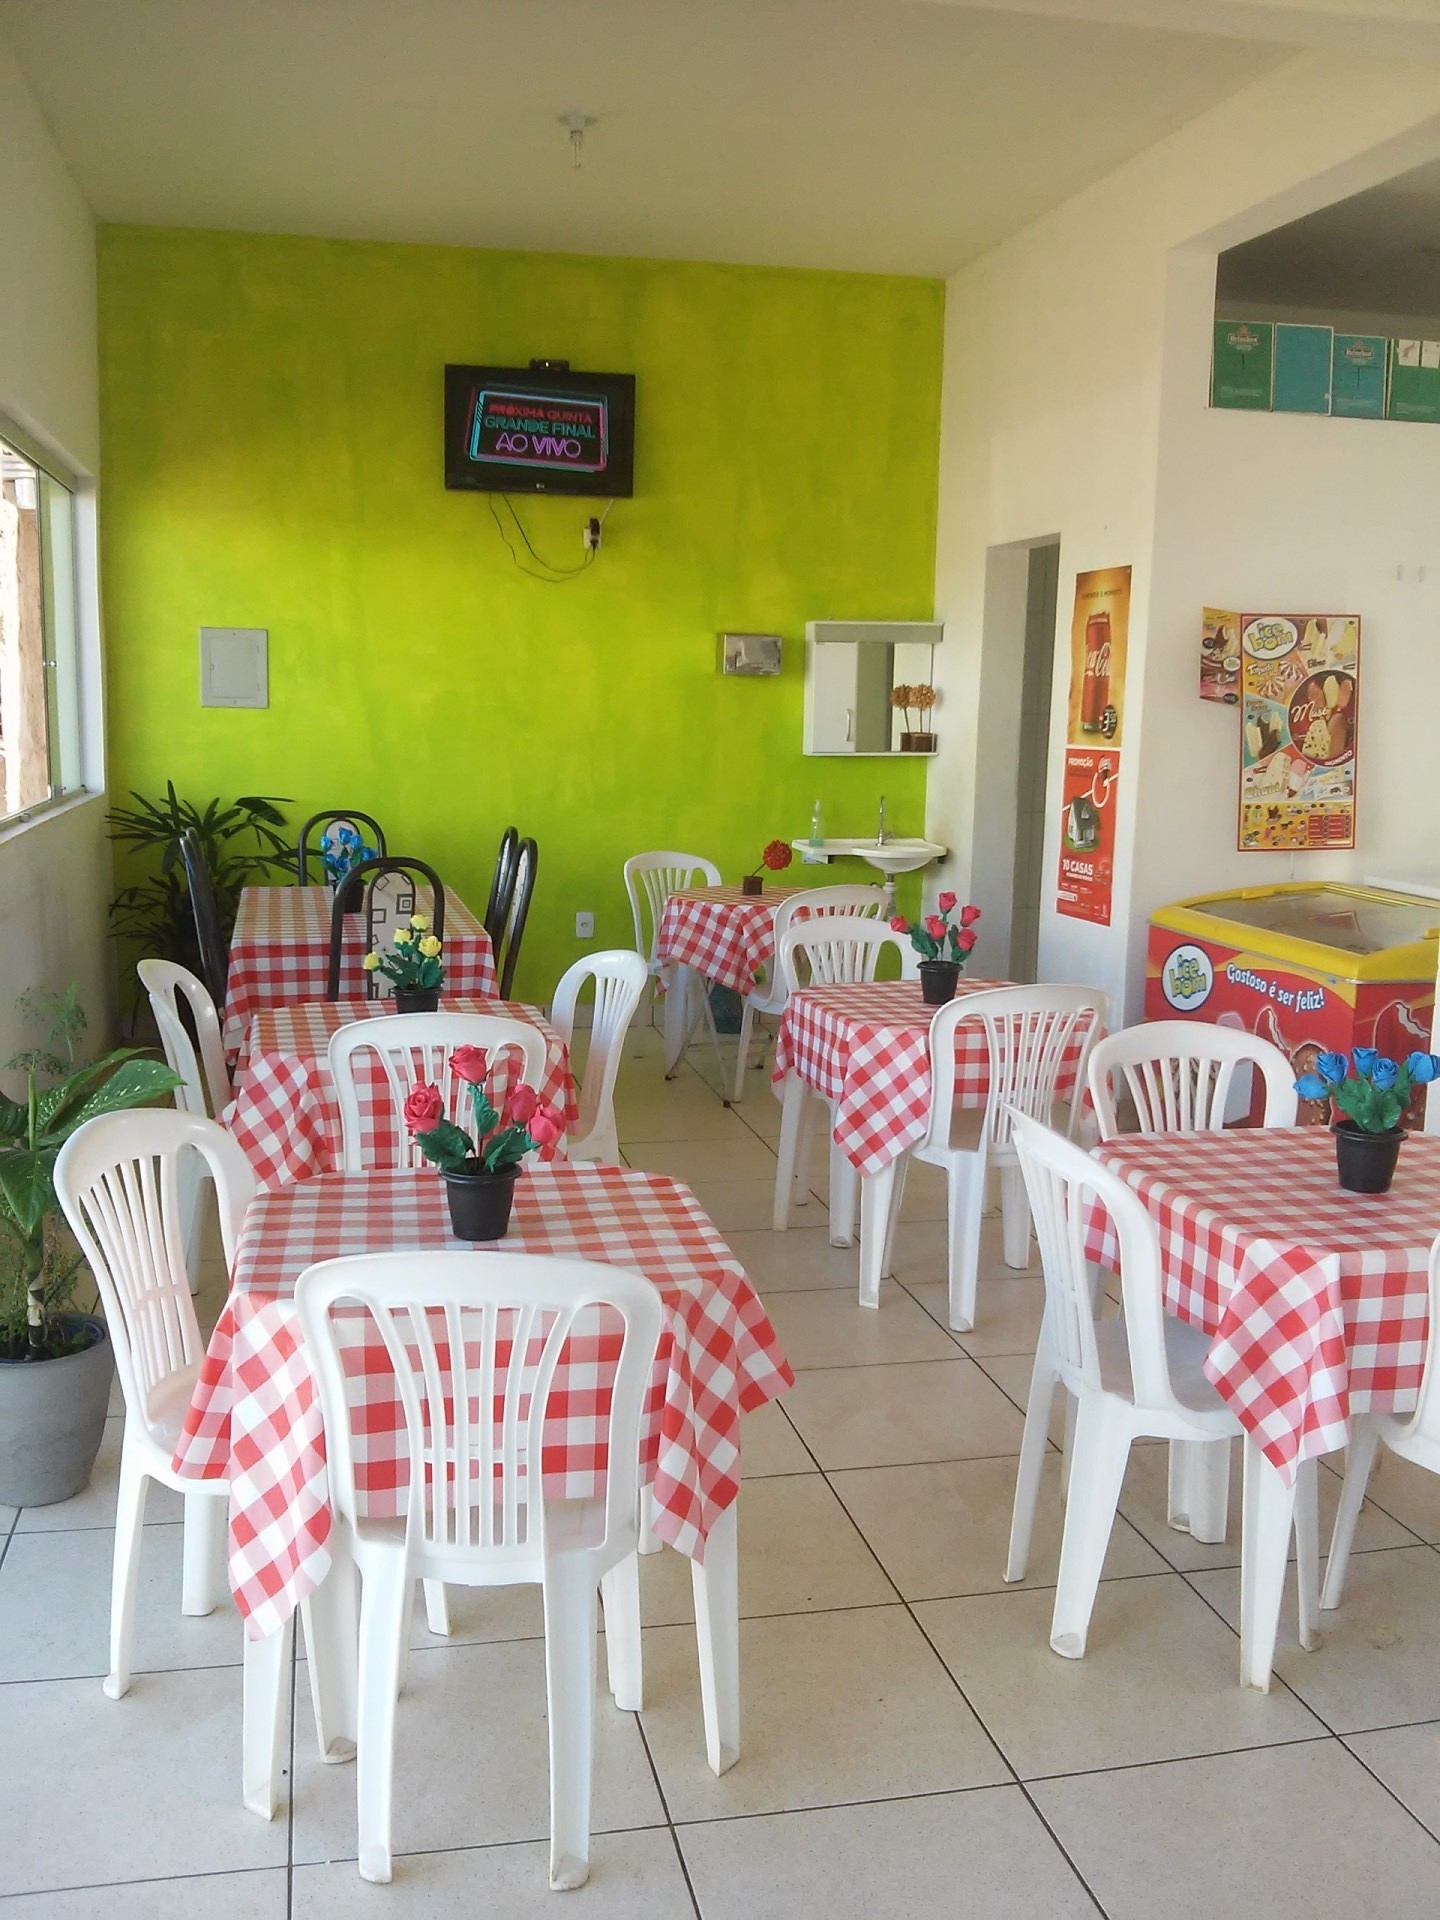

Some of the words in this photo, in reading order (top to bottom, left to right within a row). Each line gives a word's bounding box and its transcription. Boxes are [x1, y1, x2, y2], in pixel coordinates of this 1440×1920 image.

[486, 416, 548, 433] GRANDE
[552, 423, 595, 438] FINAL
[548, 410, 592, 424] QUINTA
[495, 432, 528, 452] AO
[531, 435, 581, 458] VIVO
[1062, 858, 1070, 871] 10
[1070, 860, 1094, 876] CASAS
[1177, 954, 1200, 978] ice
[1168, 968, 1207, 999] bom
[1226, 962, 1267, 993] Gostoso
[1268, 980, 1277, 998] é
[1277, 988, 1295, 1007] ser
[1296, 989, 1325, 1012] feliz!
